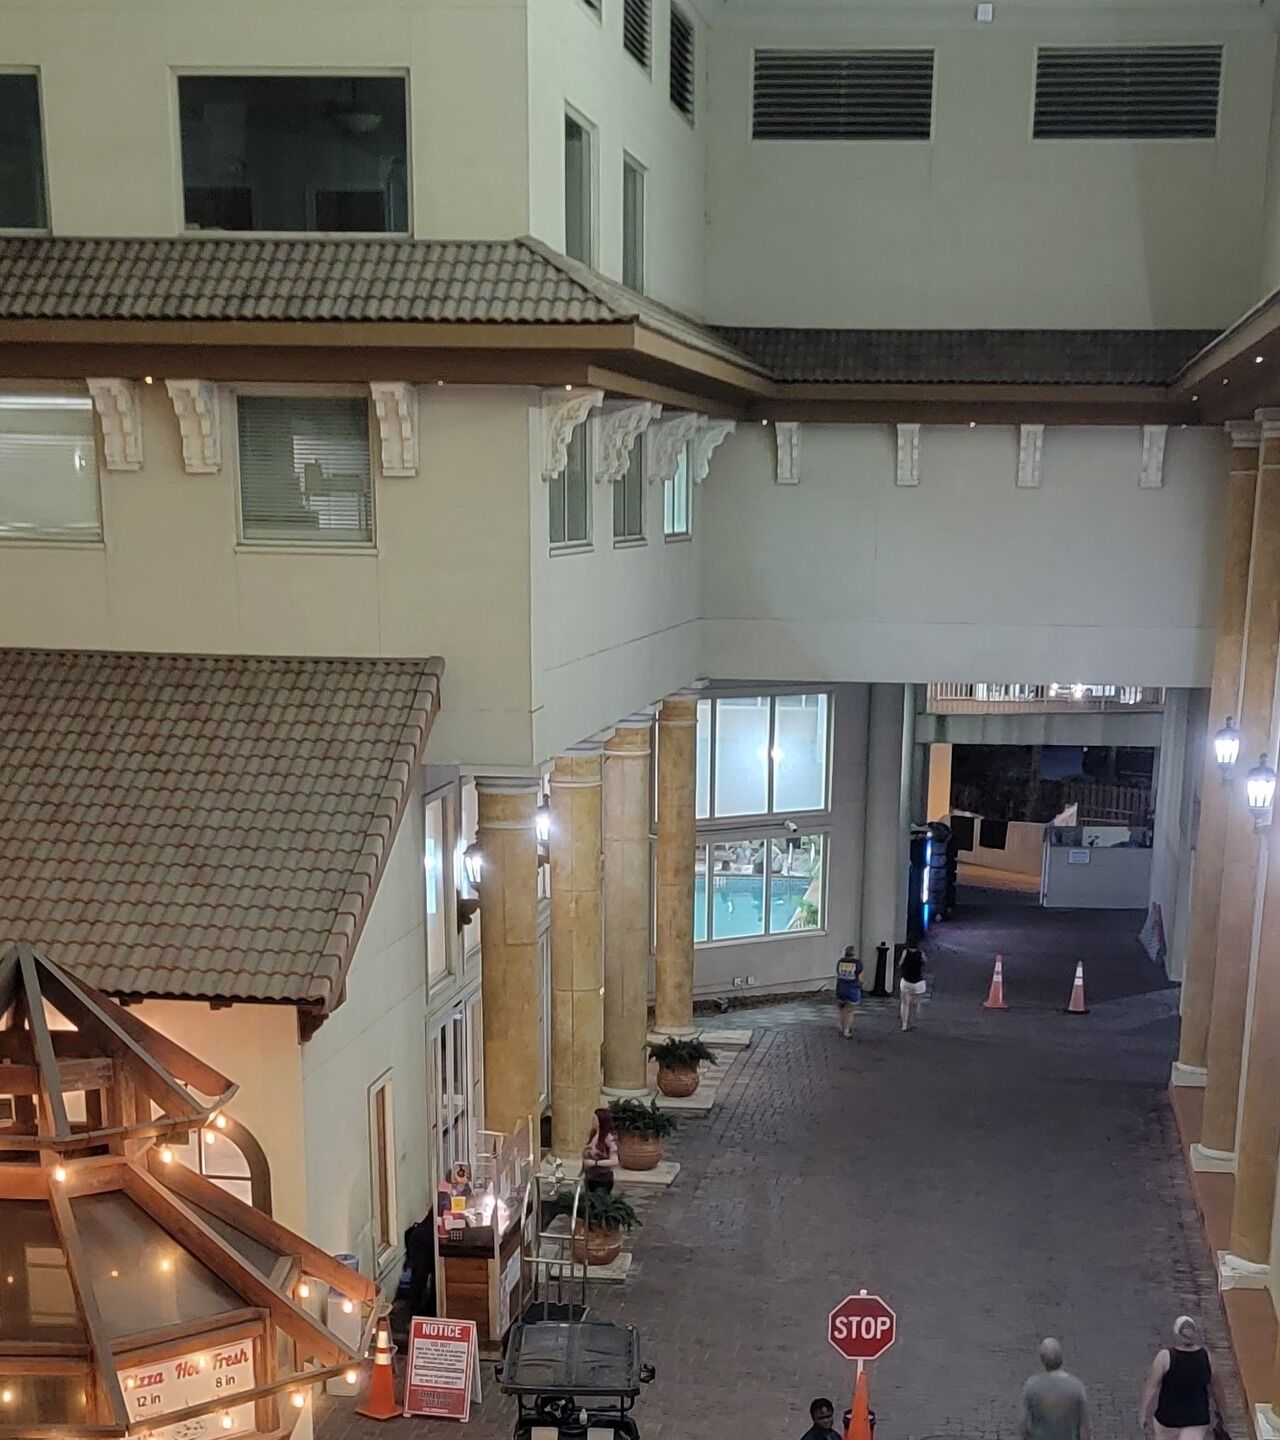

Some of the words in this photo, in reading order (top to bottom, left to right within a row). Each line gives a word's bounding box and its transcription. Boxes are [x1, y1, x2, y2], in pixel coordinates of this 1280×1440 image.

[422, 1323, 463, 1338] NOTICE
[833, 1315, 891, 1340] STOP
[213, 1348, 249, 1371] Fresh
[215, 1376, 223, 1389] 8
[225, 1374, 236, 1387] in
[136, 1395, 148, 1408] 12
[151, 1393, 162, 1405] in
